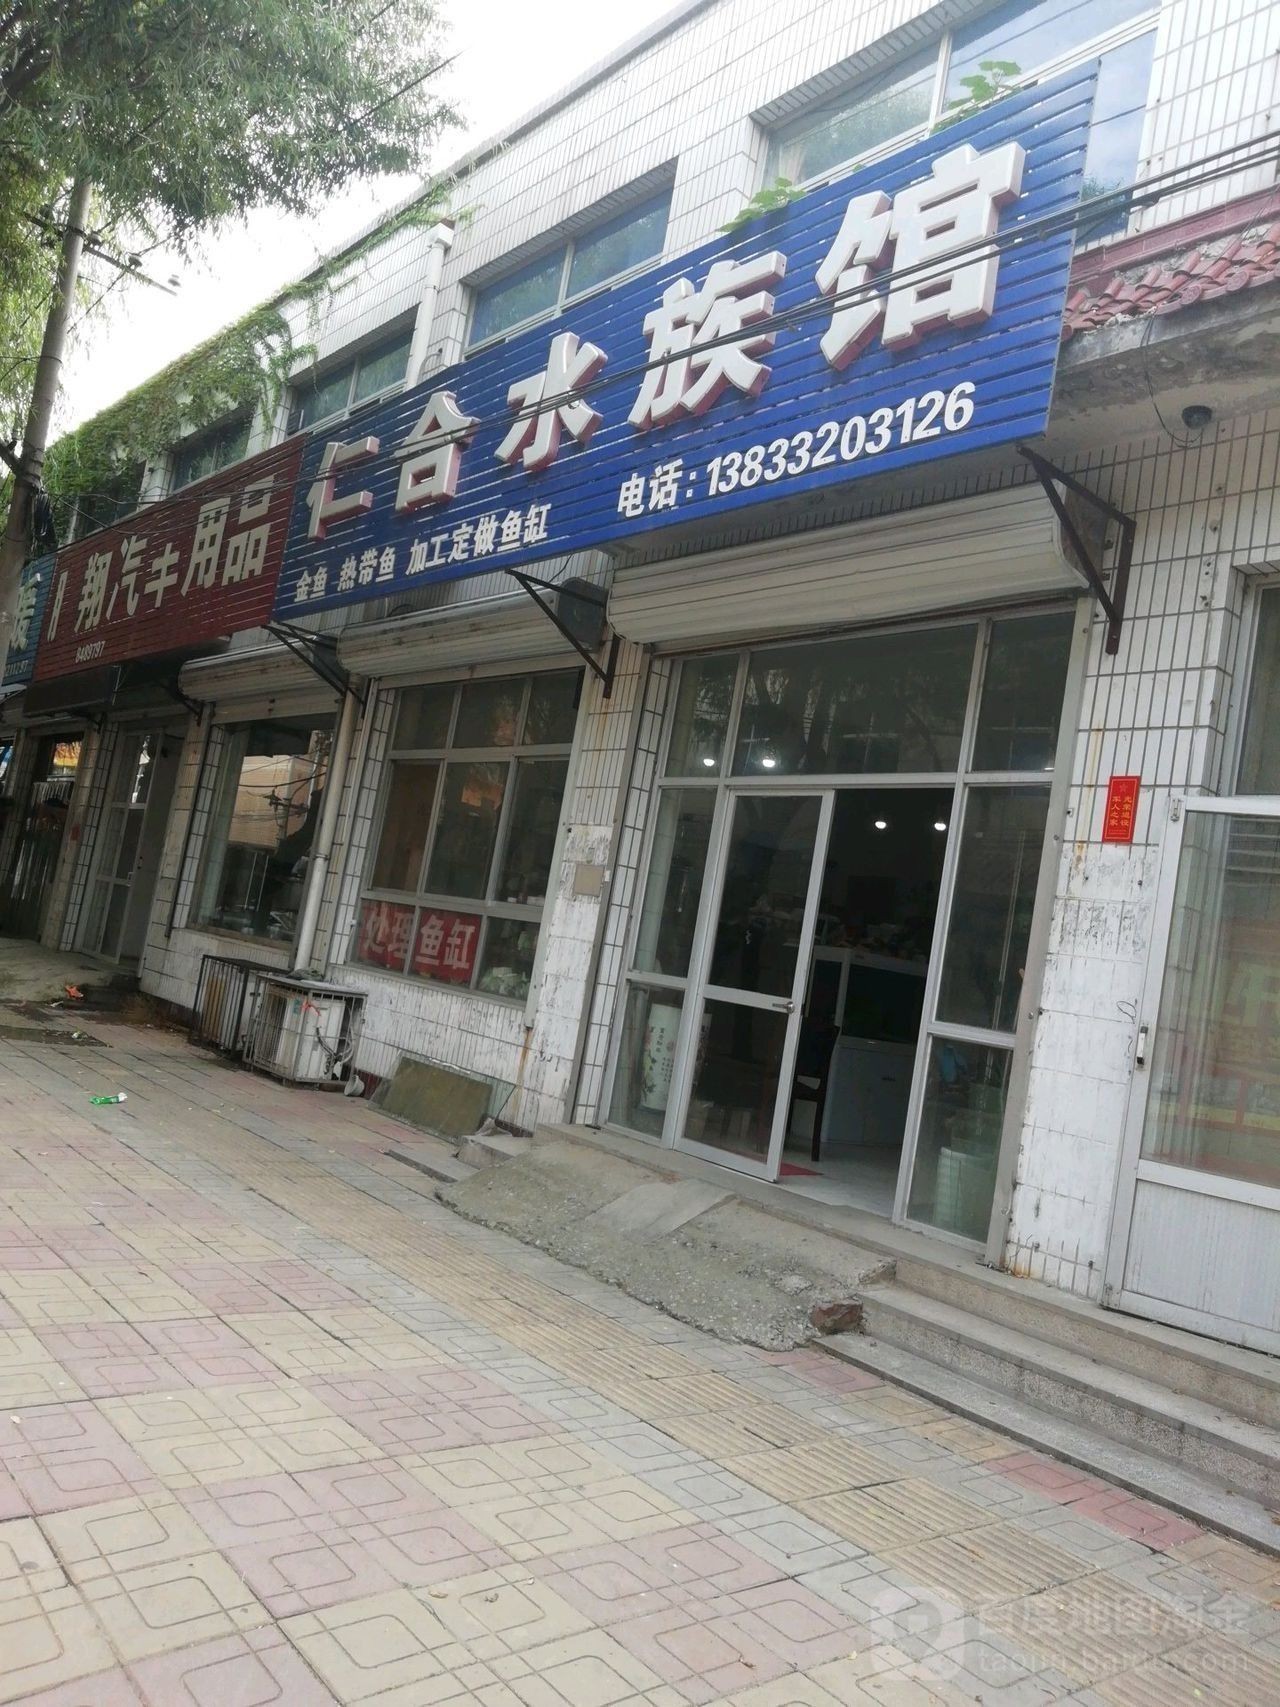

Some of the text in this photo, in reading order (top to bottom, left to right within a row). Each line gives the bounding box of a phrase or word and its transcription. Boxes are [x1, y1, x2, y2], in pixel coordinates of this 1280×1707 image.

[305, 142, 1026, 540] 仁合水族馆
[294, 503, 552, 602] 金鱼 热带鱼 加工定做鱼缸
